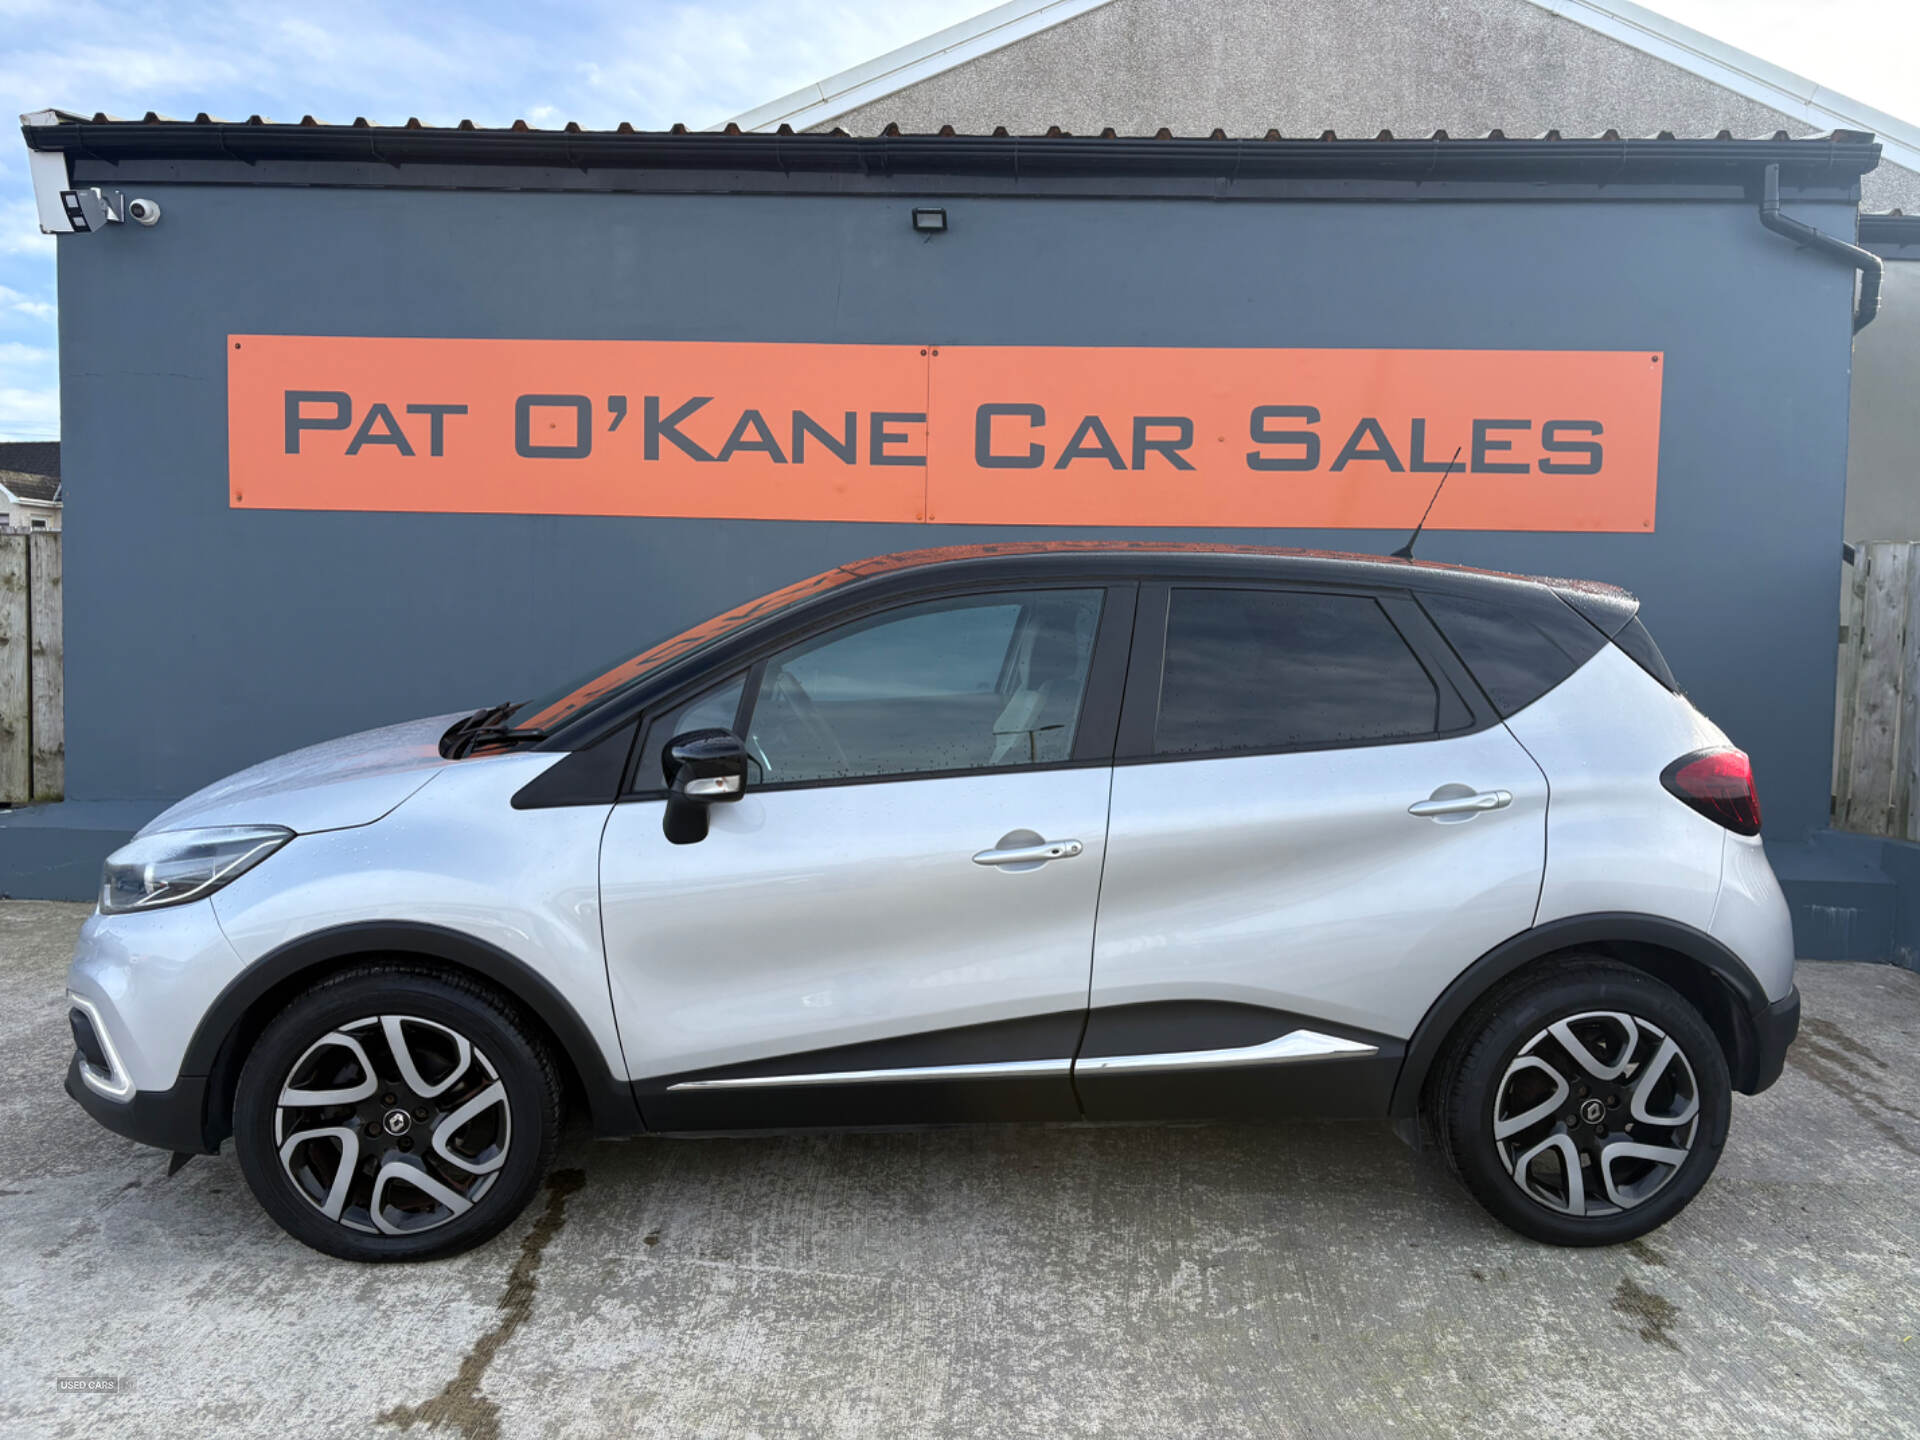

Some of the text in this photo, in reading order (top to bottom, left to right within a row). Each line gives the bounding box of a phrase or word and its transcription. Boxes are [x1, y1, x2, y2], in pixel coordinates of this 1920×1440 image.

[284, 390, 469, 457] PAT
[975, 403, 1196, 471] CAR
[1246, 405, 1604, 475] SALES
